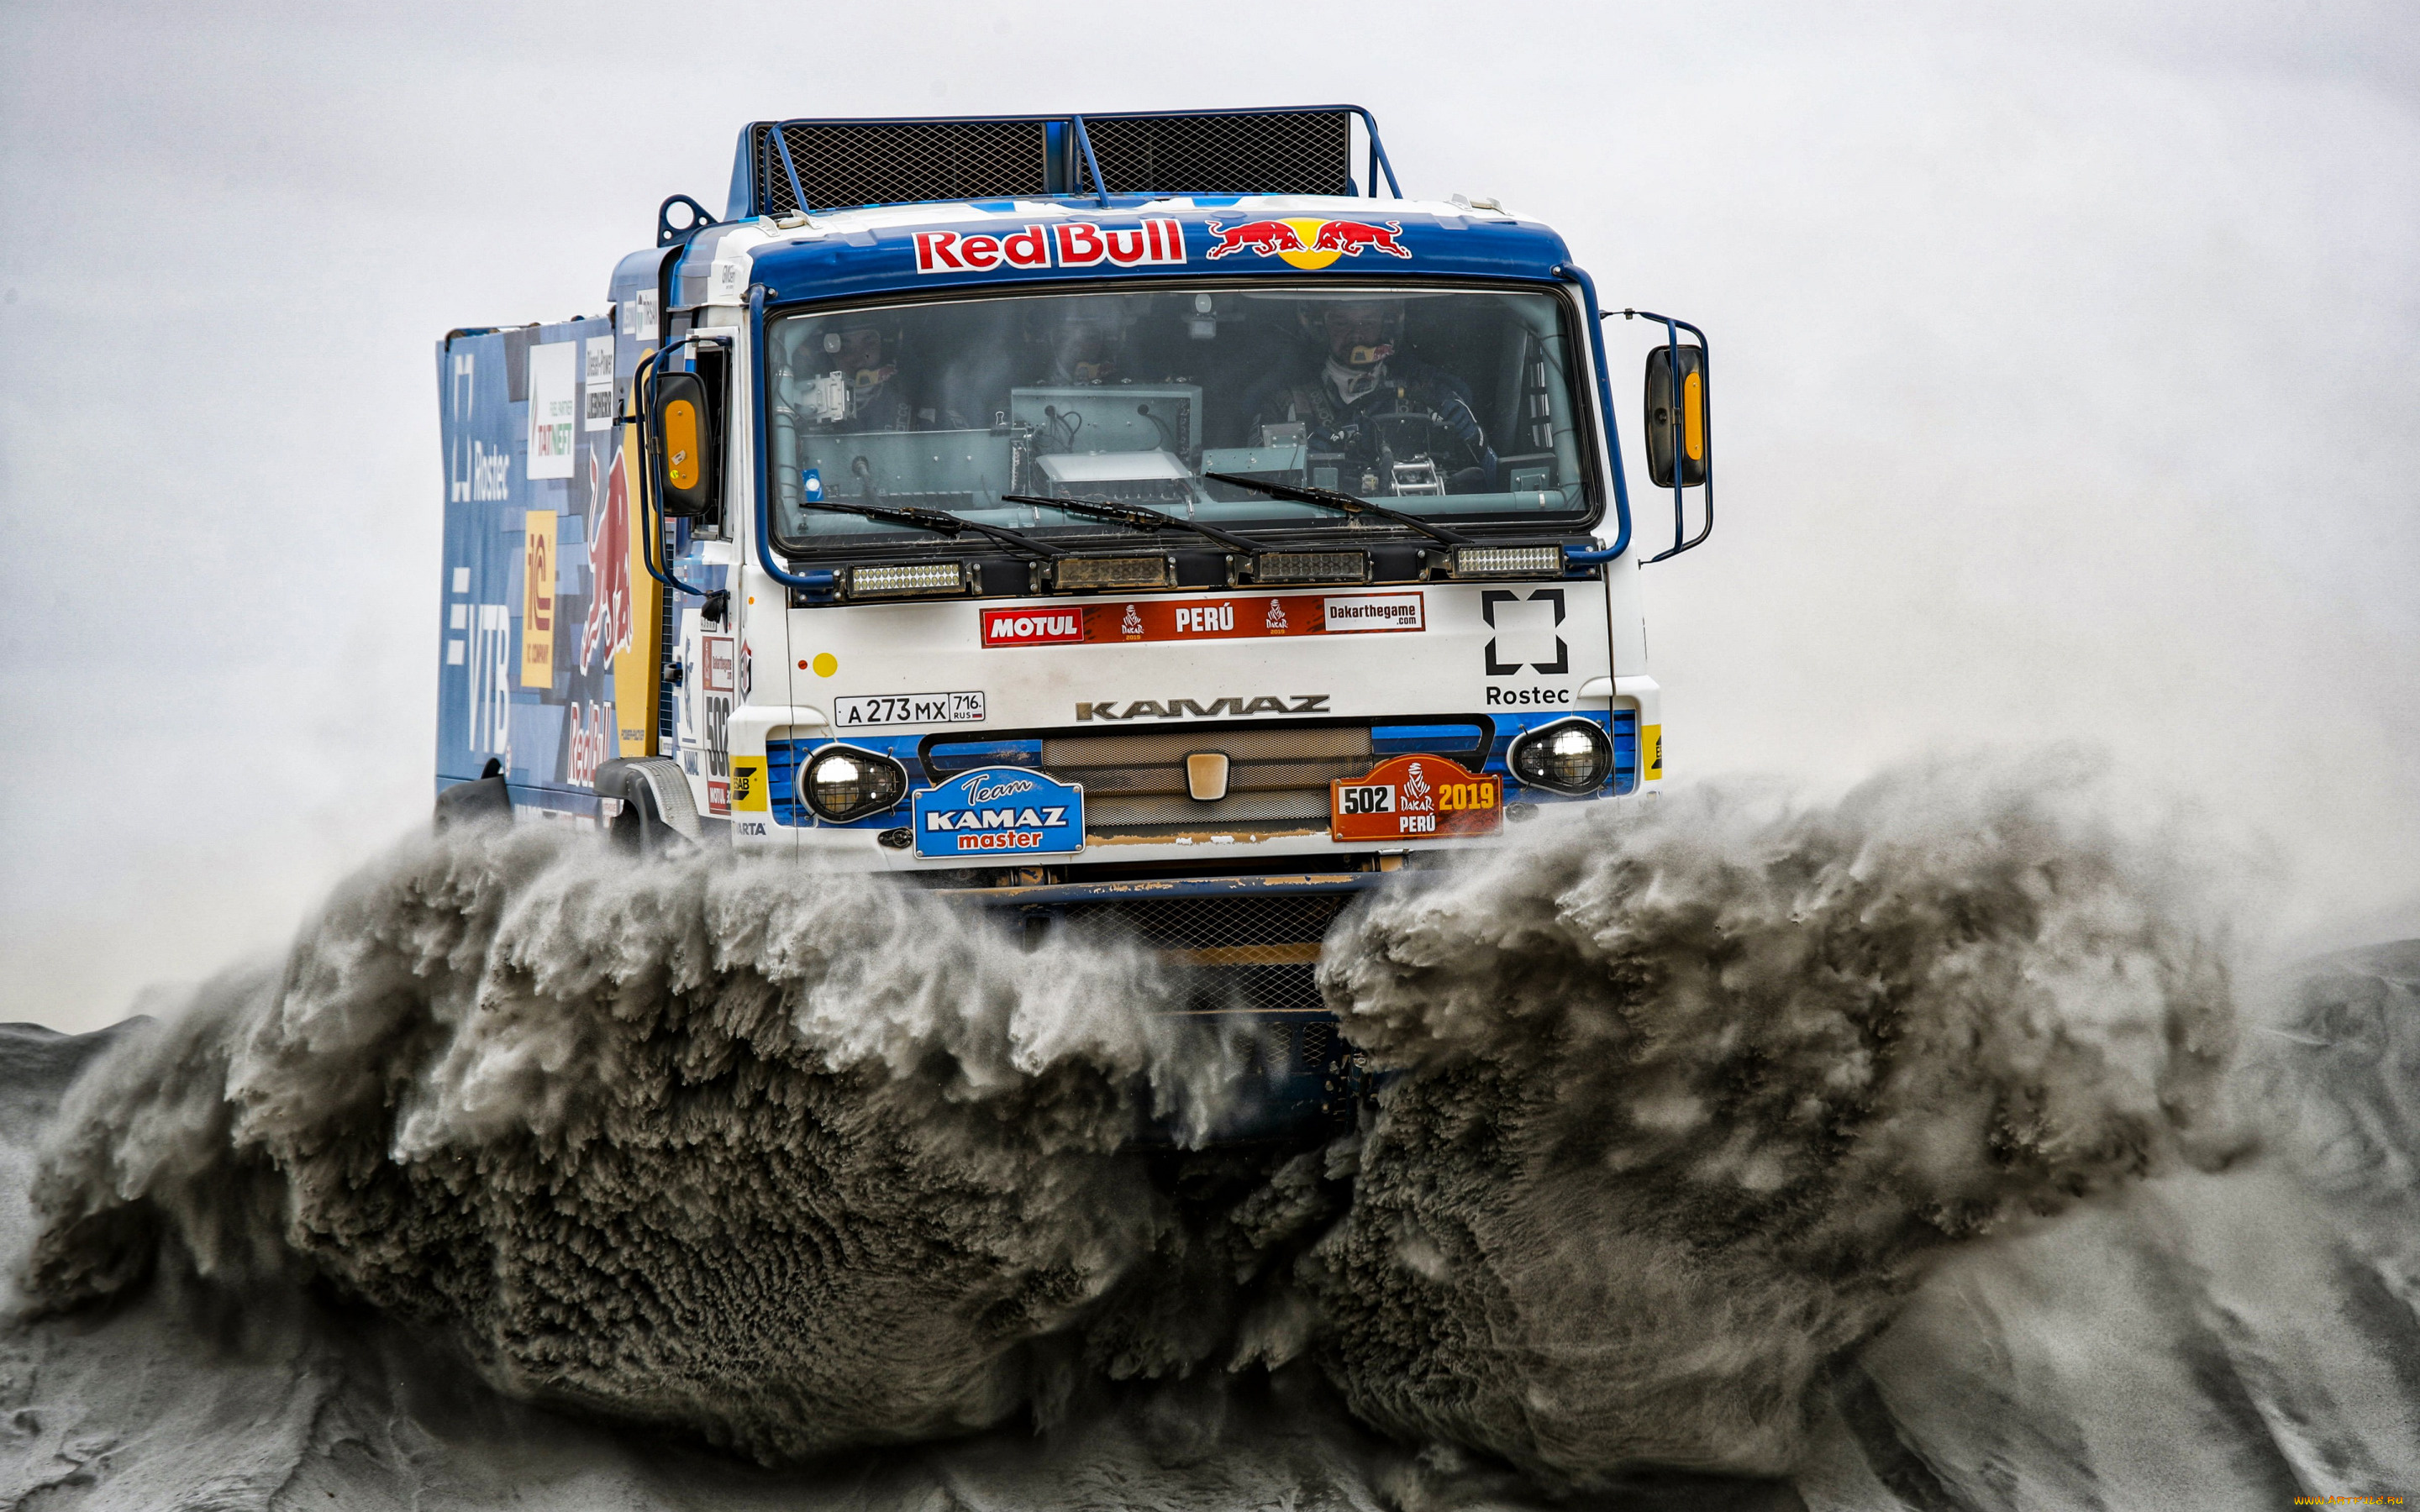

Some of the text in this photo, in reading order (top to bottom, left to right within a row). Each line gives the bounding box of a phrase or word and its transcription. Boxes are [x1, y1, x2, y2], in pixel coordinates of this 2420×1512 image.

[912, 218, 1187, 275] Red Bull
[587, 391, 612, 419] LIEBHERR
[538, 423, 572, 456] TATNEFT
[473, 440, 511, 502] Rostec
[1176, 602, 1234, 633] PERÚ
[1266, 618, 1288, 628] DAKAR
[1329, 602, 1416, 620] Dakarthegame
[1397, 615, 1417, 625] .com
[990, 615, 1077, 638] MOTUL
[1122, 624, 1144, 634] DAKAR
[468, 604, 511, 754] VTB
[954, 694, 979, 710] 716
[1486, 686, 1570, 705] Rostec
[1075, 695, 1331, 723] KAMAZ
[567, 700, 593, 787] Red
[962, 774, 1033, 806] Team
[1344, 786, 1389, 814] 502
[1439, 782, 1494, 811] 2019
[1400, 795, 1434, 812] DAKAR
[733, 822, 766, 835] ARTA
[926, 806, 1069, 832] KAMAZ
[1399, 813, 1435, 833] PERÚ
[957, 830, 1043, 851] master
